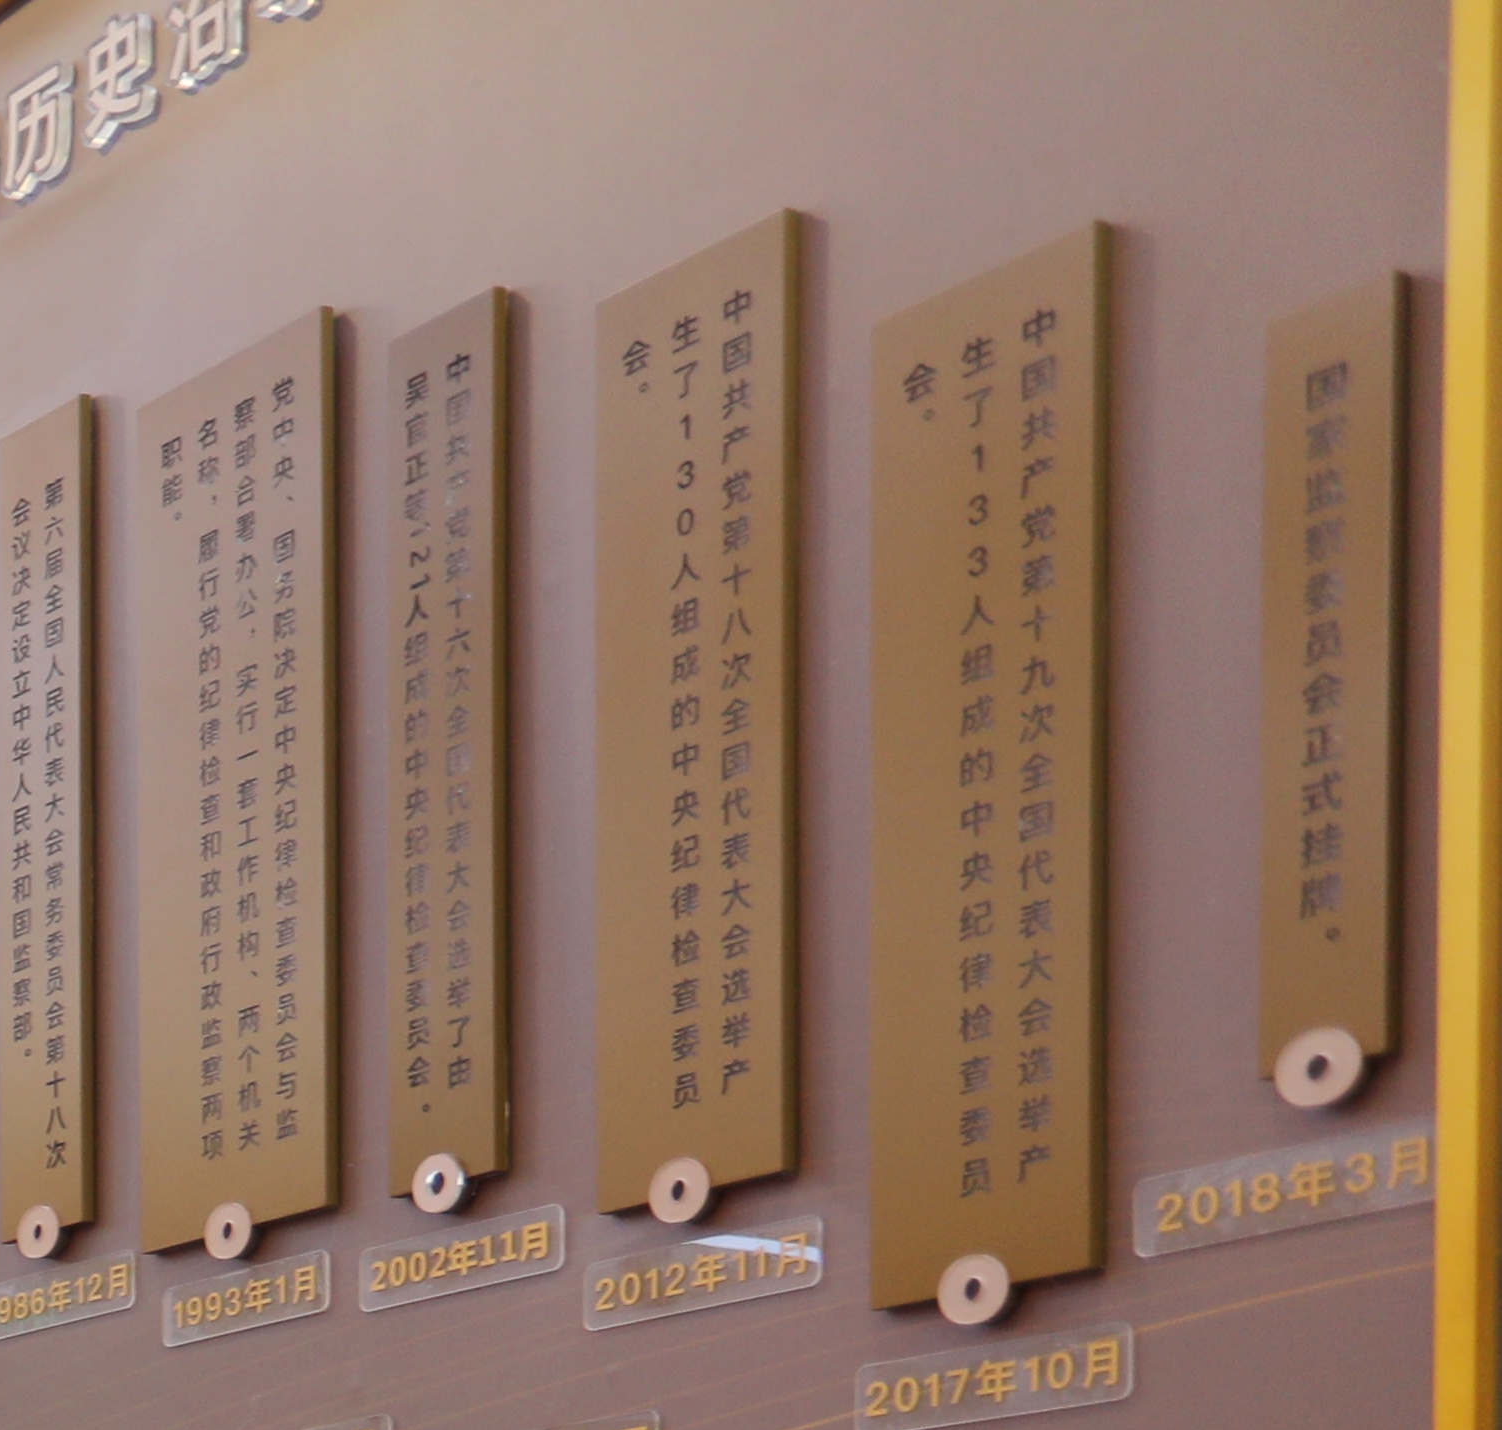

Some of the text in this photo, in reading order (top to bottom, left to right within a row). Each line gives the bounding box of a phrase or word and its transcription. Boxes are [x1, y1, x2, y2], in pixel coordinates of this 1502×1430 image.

[621, 339, 652, 394] 会。
[902, 362, 939, 422] 会。
[160, 435, 184, 521] 职能。
[670, 314, 700, 1110] 生了130人组成的中央纪律检查委员
[721, 290, 752, 1097] 中国共产党第十八次全国代表大会选举产
[11, 497, 33, 1058] 会议决定设立中华人民共和国监察部。
[958, 336, 995, 1199] 生了133人组成的中央纪律检查委员
[1018, 308, 1058, 1185] 中国共产党第十九次全国代表大会选举产
[44, 477, 67, 1170] 第六届全国人民代表大会常务委员会第十八次
[1156, 1135, 1429, 1234] 2018年3月
[173, 1264, 318, 1328] 1993年1月
[369, 1220, 550, 1293] 2002年11月
[595, 1232, 811, 1311] 2012年11月
[864, 1339, 1122, 1419] 2017年10月
